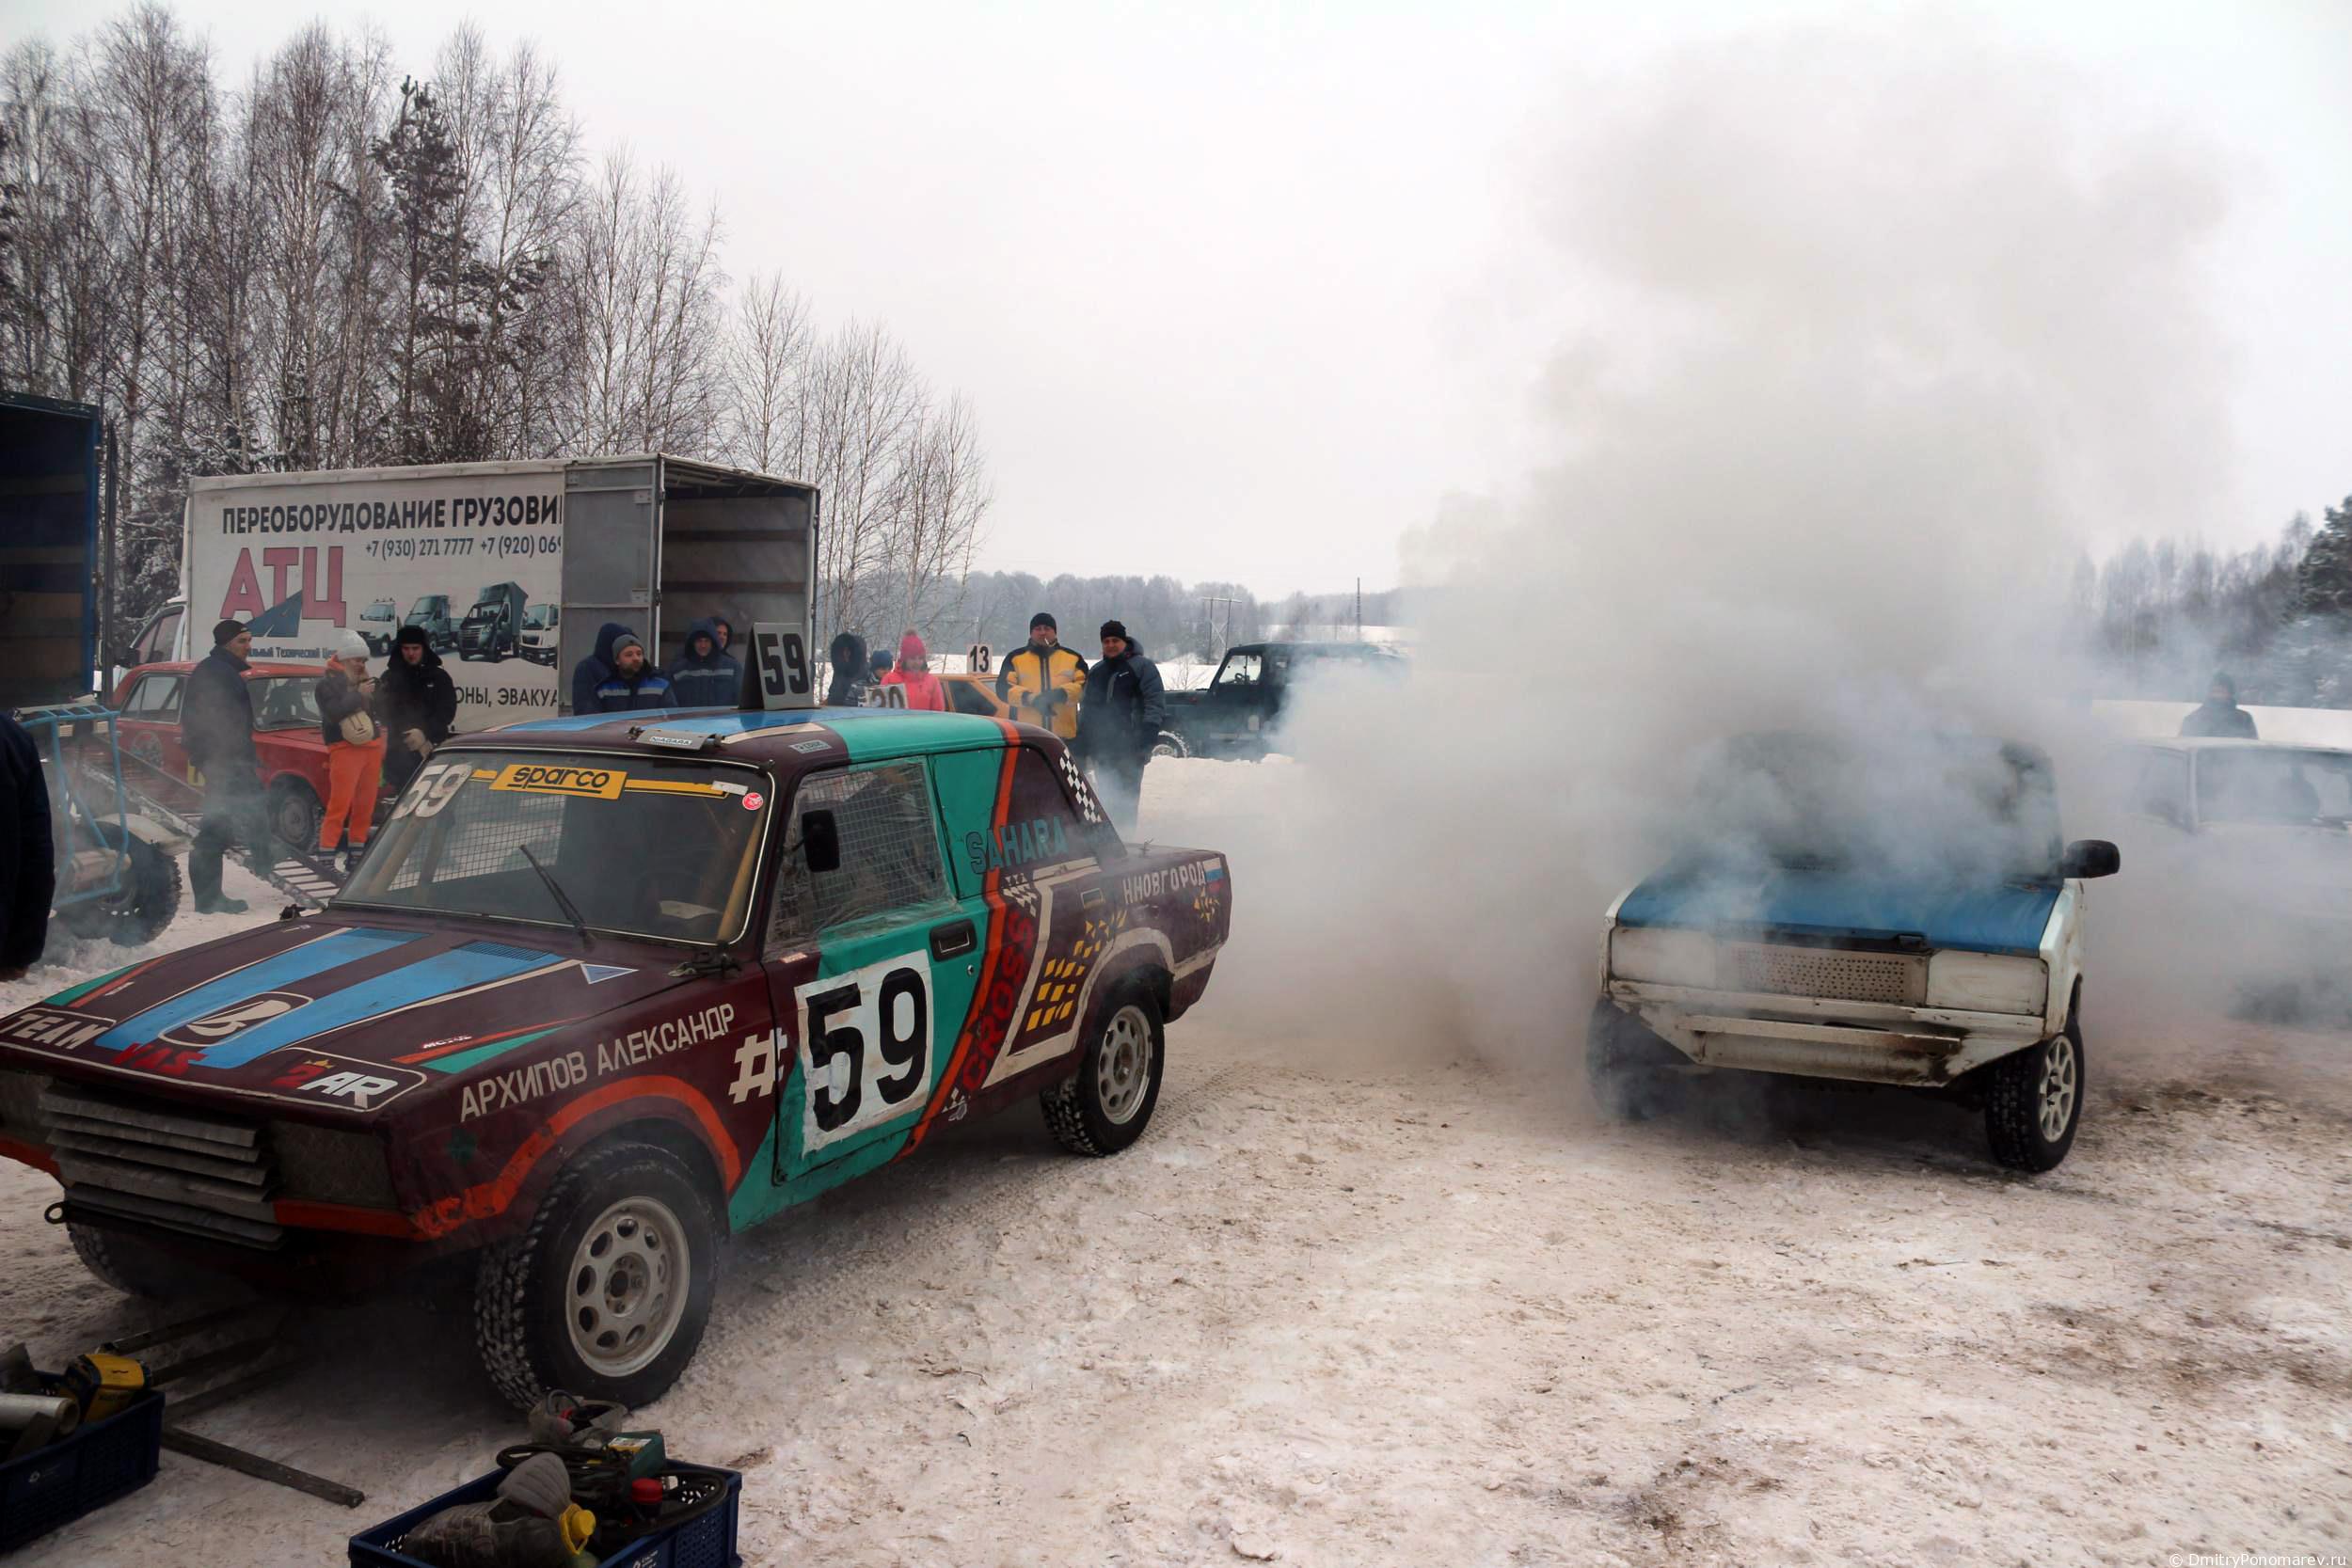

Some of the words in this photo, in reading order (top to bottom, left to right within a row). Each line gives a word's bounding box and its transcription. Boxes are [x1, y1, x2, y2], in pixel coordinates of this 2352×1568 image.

[222, 499, 446, 534] ПЕРЕОБОРУДОВАНИЕ
[452, 495, 563, 528] ГРУЗОВИ
[365, 541, 379, 557] +7
[382, 537, 416, 562] (930)
[419, 539, 440, 556] 271
[443, 538, 474, 555] 7777
[481, 537, 495, 556] +7
[498, 534, 534, 559] (920)
[219, 546, 346, 628] АТЦ
[757, 632, 810, 695] 59
[969, 645, 990, 673] 13
[390, 762, 472, 820] 59
[513, 766, 610, 789] sparco
[965, 816, 1069, 875] SAHARA
[962, 909, 1034, 1091] CROSS
[1, 1012, 110, 1050] TEAM
[805, 967, 927, 1132] 59
[459, 1051, 588, 1123] АРХИПОВ
[597, 1003, 736, 1076] АЛЕКСАНДР
